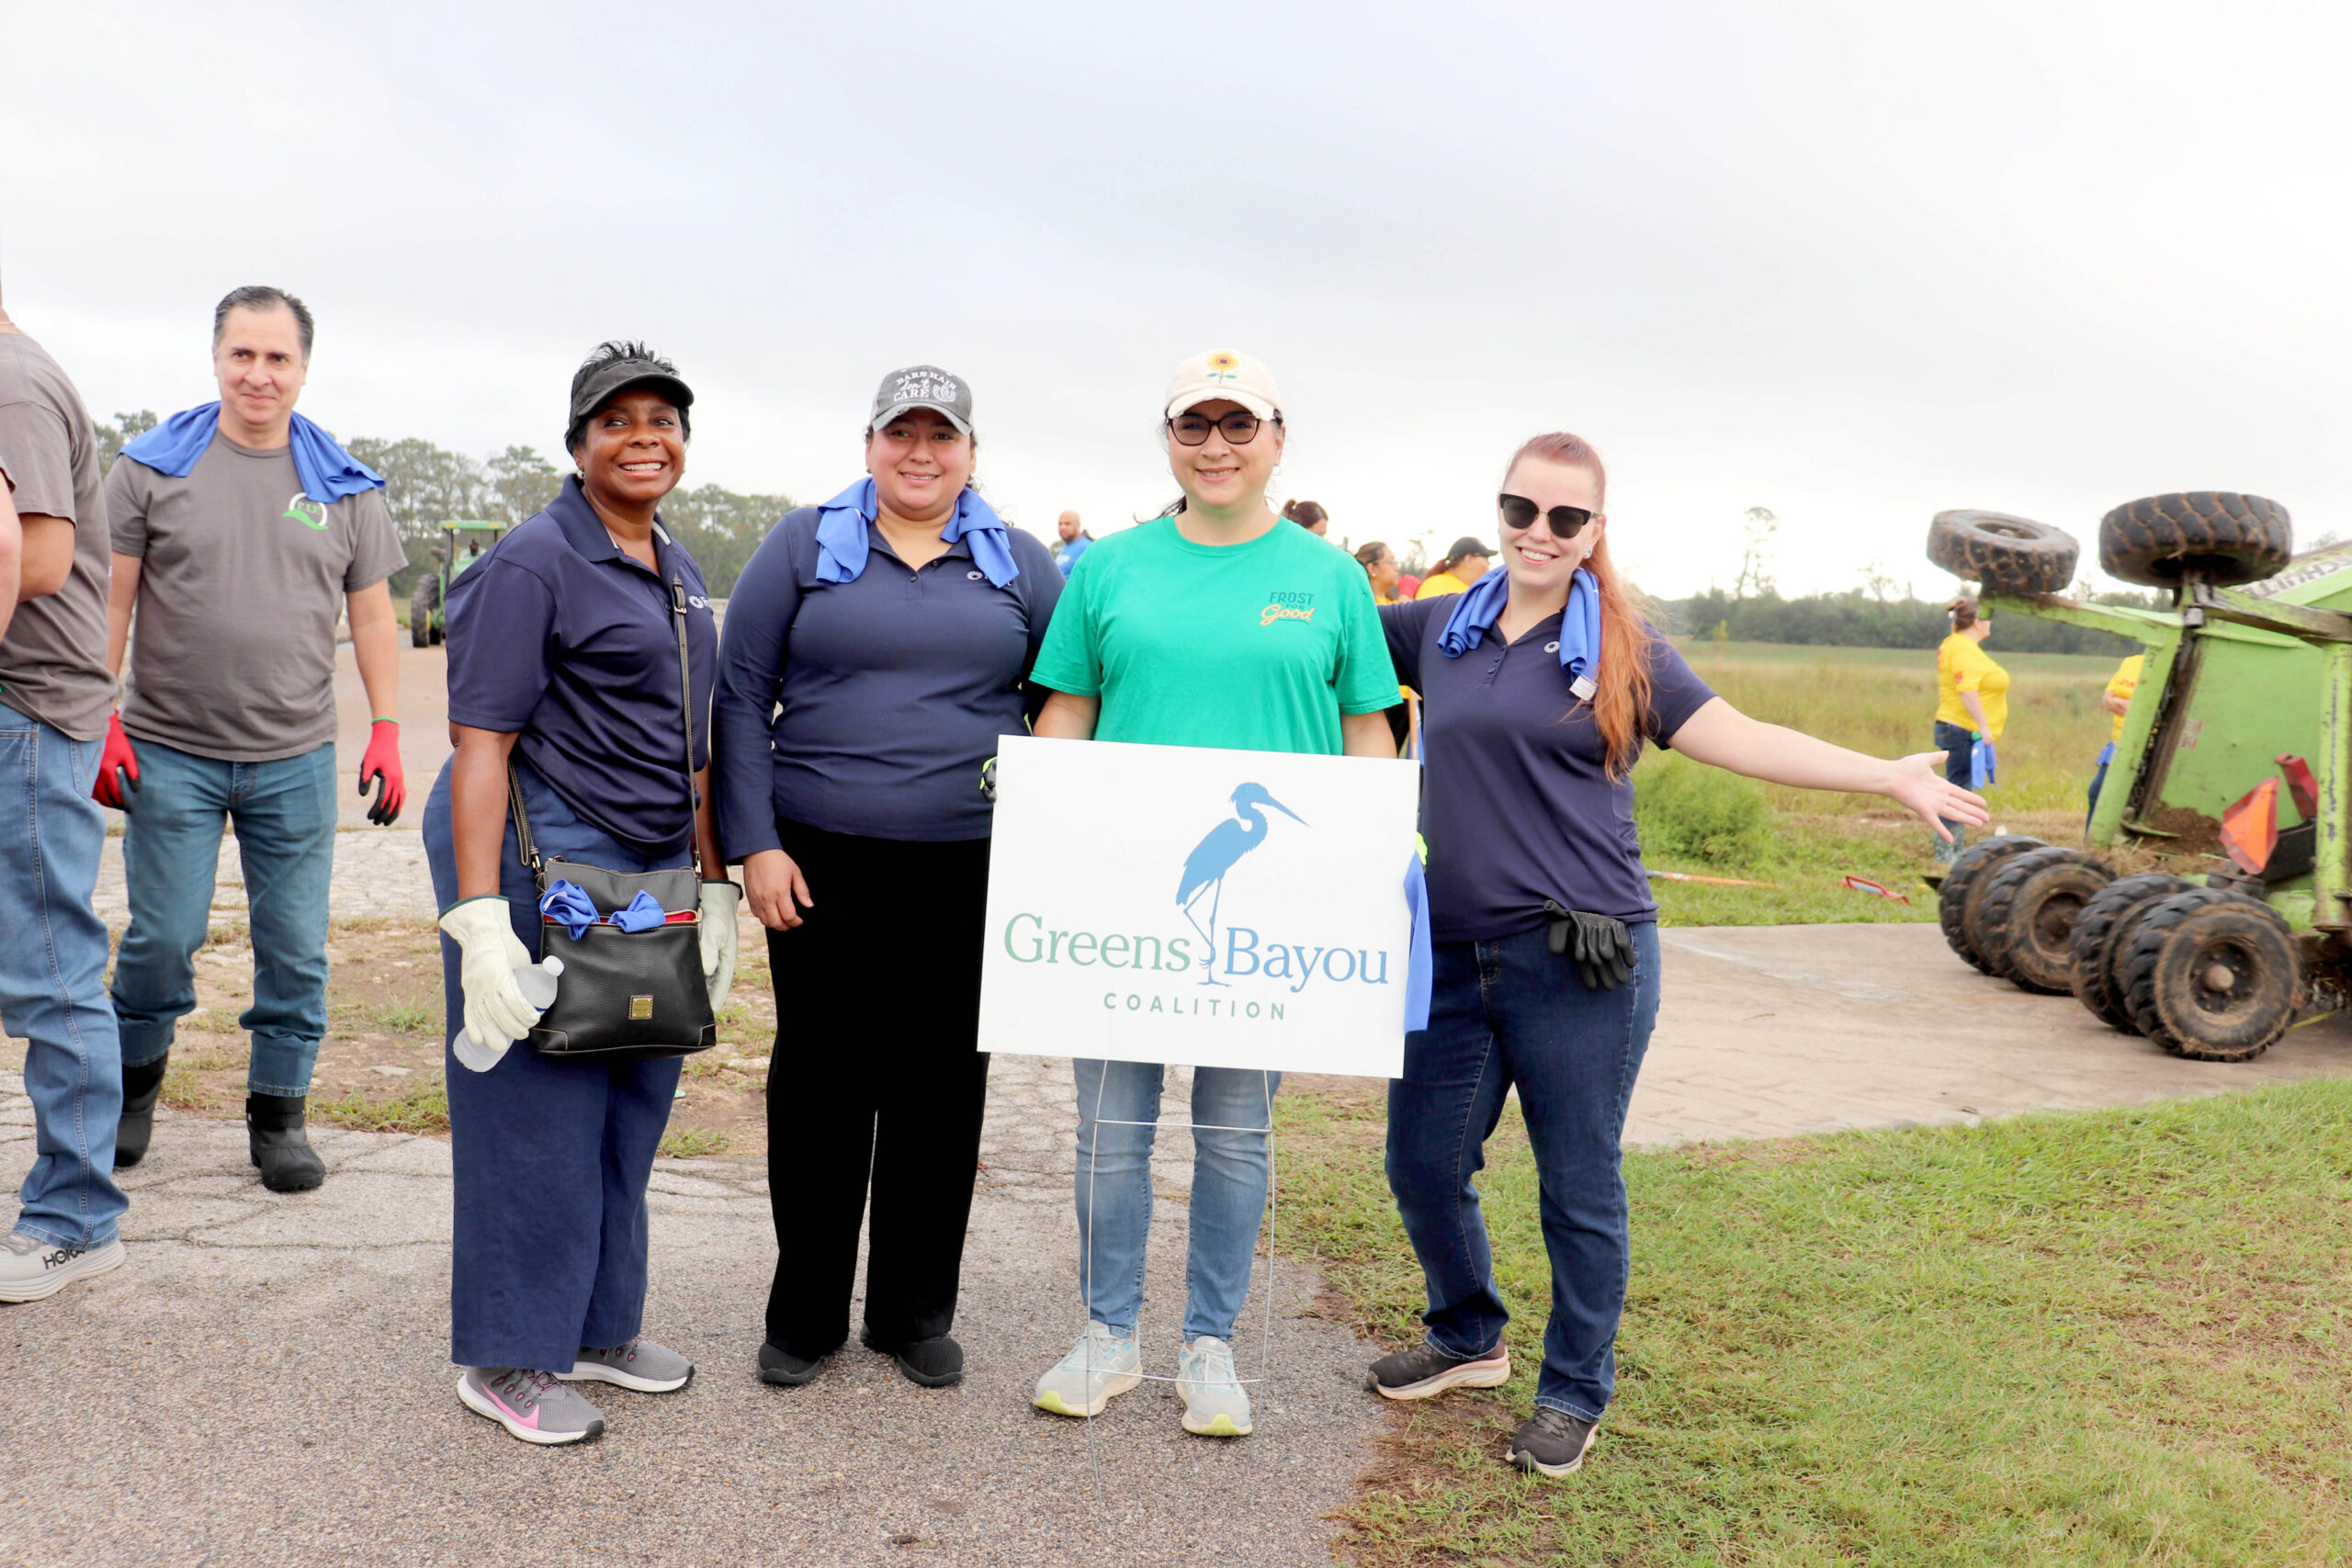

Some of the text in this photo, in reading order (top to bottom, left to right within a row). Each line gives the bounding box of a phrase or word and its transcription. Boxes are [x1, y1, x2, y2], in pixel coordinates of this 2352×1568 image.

[896, 371, 957, 389] BARN HAIR
[900, 378, 930, 391] don't
[894, 388, 930, 402] CARE
[1269, 592, 1315, 605] FROST
[1260, 604, 1316, 626] Good
[1004, 912, 1389, 993] Greens Bayou
[1103, 992, 1284, 1021] COALITION
